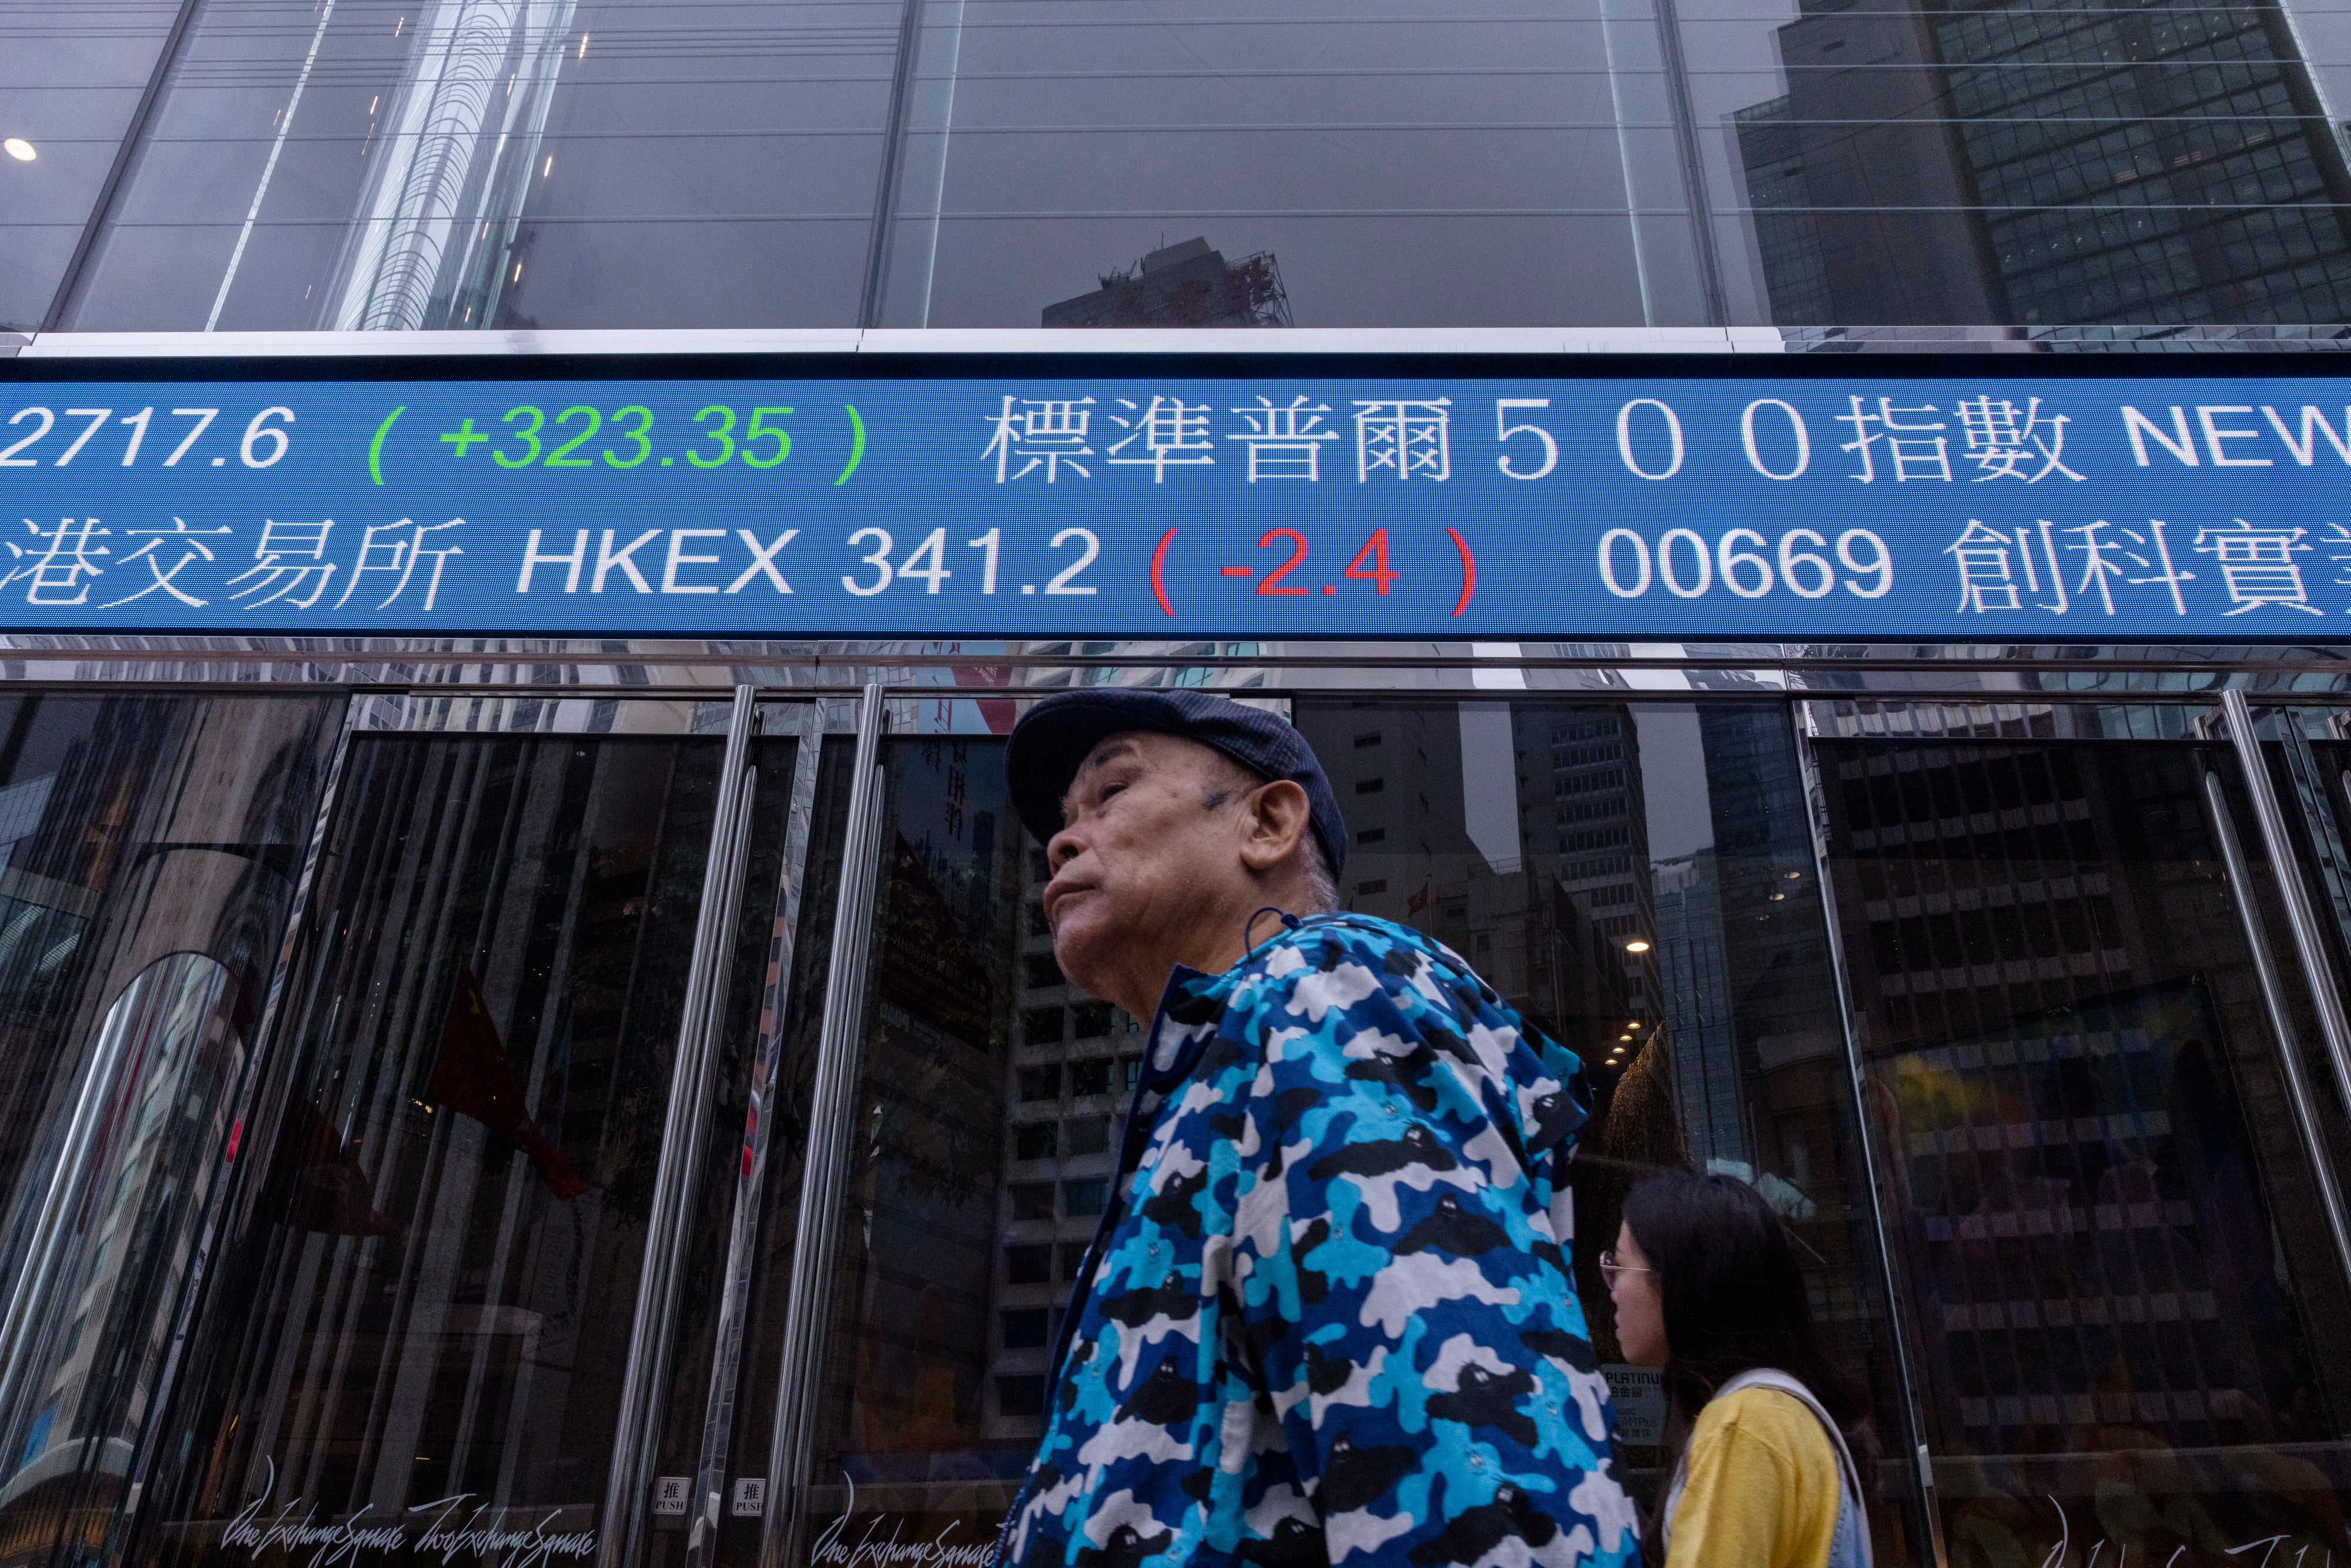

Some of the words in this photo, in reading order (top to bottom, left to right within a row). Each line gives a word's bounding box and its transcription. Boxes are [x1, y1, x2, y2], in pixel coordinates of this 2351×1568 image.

[0, 406, 295, 468] 2717.6
[440, 406, 792, 468] +323.35
[2121, 406, 2351, 466] NEW
[0, 517, 465, 611] 港交易所
[517, 529, 798, 594] HKEX
[842, 528, 1099, 595] 341.2
[1221, 528, 1399, 595] -2.4
[1598, 528, 1893, 598] 00669
[1605, 1372, 1660, 1384] PLATINU
[655, 1500, 685, 1510] PUSH
[664, 1482, 679, 1499] 推
[744, 1483, 759, 1500] 推
[220, 1455, 274, 1550] One
[252, 1496, 348, 1568] Exchange
[325, 1502, 407, 1568] Square
[441, 1502, 538, 1568] Exchange
[517, 1507, 597, 1568] Square
